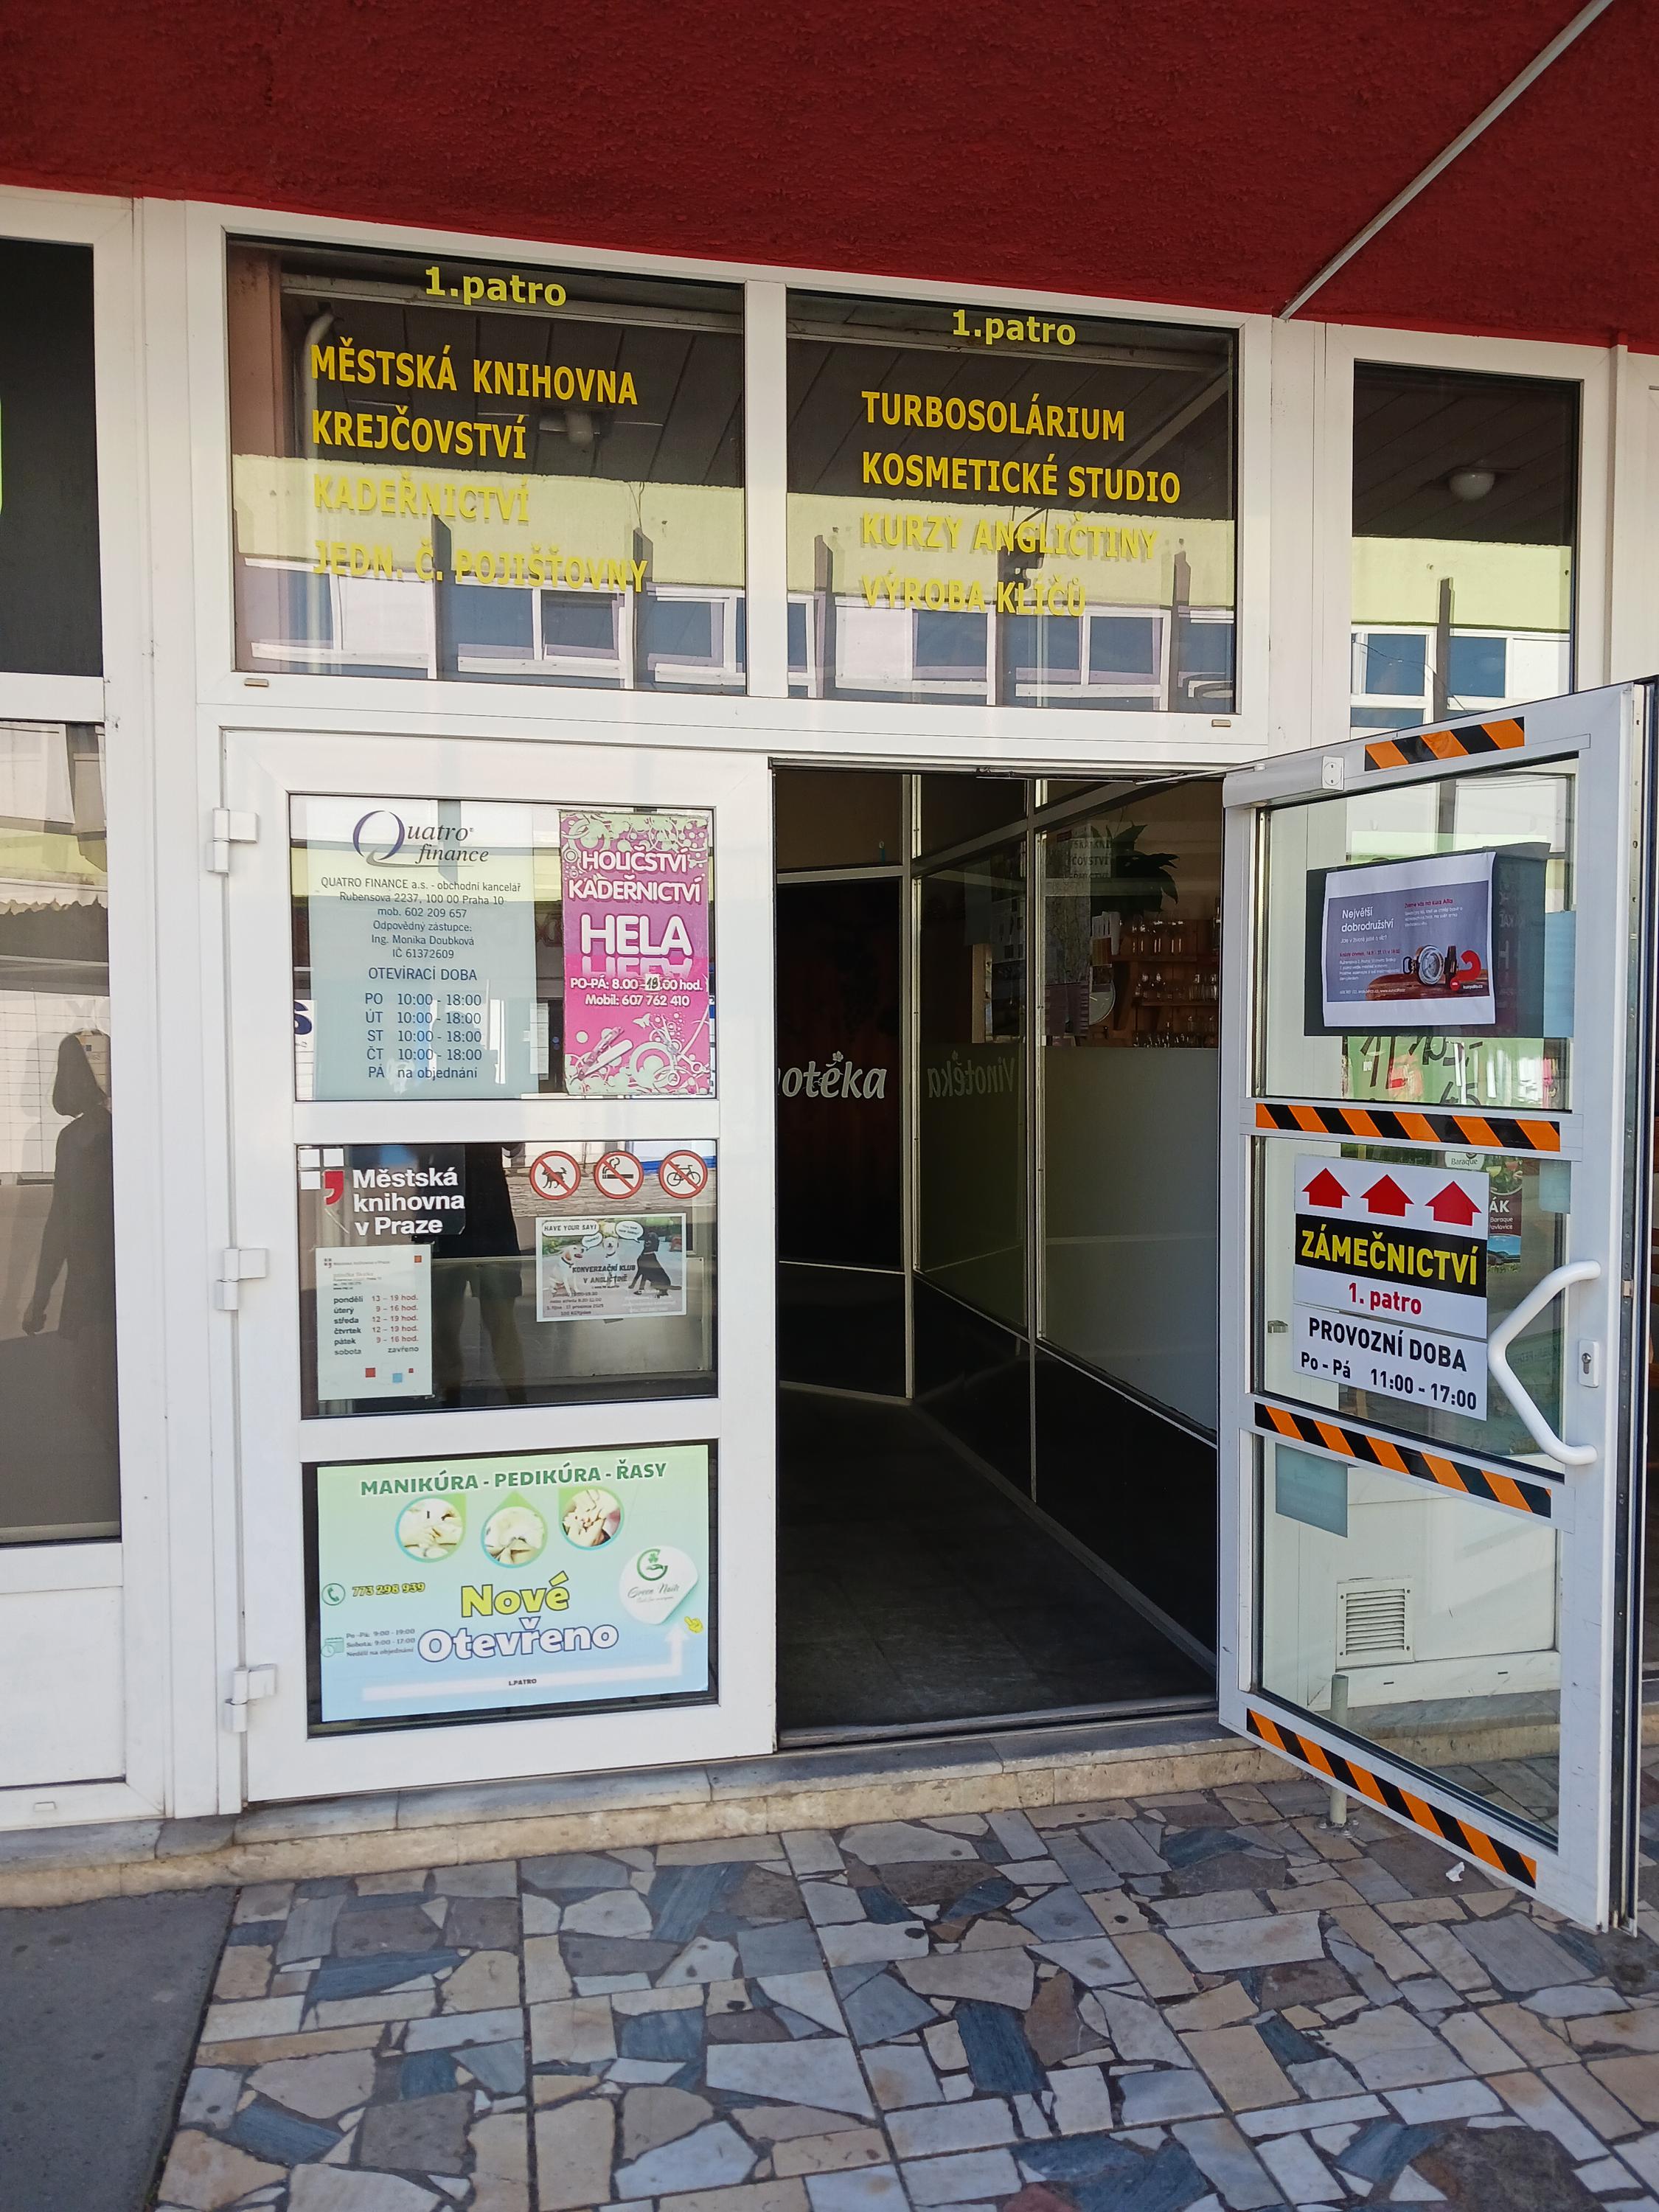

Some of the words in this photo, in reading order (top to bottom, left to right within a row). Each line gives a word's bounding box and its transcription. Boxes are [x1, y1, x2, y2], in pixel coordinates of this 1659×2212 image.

[425, 266, 566, 306] 1.patro
[953, 309, 1077, 346] 1.patro
[311, 336, 457, 392] MĚSTSKÁ
[473, 360, 639, 406] KNIHOVNA
[861, 391, 1125, 442] TURBOSOLÁRIUM
[313, 406, 526, 460] KREJČOVSTVÍ
[863, 451, 1058, 496] KOSMETICKÉ
[1068, 465, 1180, 504] STUDIO
[314, 470, 530, 523] KADEŘNICTVÍ
[862, 512, 963, 549] KURZY
[973, 517, 1159, 560] ANGLIČTINY
[313, 540, 403, 581] JEDN.
[415, 537, 444, 582] Č.
[456, 543, 648, 593] POJIŠŤOVNY
[862, 568, 986, 613] VÝROBA
[997, 577, 1086, 617] KLÍČŮ
[415, 843, 489, 864] finance
[581, 845, 691, 874] HOLIČSTVÍ
[321, 877, 361, 889] QUATRO
[366, 878, 408, 889] FINANCE
[411, 881, 428, 889] a.s.
[437, 881, 479, 891] obchodní
[482, 882, 521, 892] kancelář
[568, 873, 703, 903] KADEŘNICTVÍ
[339, 891, 391, 902] Rubensova
[426, 894, 443, 904] 100
[447, 894, 459, 904] 00
[462, 895, 489, 905] Praha
[493, 896, 504, 905] 10
[378, 907, 401, 917] mob.
[405, 908, 423, 917] 602
[427, 908, 446, 917] 209
[449, 908, 467, 918] 657
[1342, 906, 1374, 919] Největší
[373, 919, 424, 932] Odpovědný
[428, 922, 473, 932] zástupce:
[580, 914, 694, 957] HELA
[1341, 918, 1394, 933] dobrodružství
[372, 934, 389, 945] Ing.
[392, 935, 426, 945] Monika
[429, 936, 474, 945] Doubková
[392, 947, 403, 958] IČ
[406, 949, 454, 959] 61372609
[369, 965, 436, 980] OTEVÍRACÍ
[441, 969, 478, 981] DOBA
[679, 979, 703, 991] hod.
[365, 992, 383, 1004] PO
[397, 993, 433, 1005] 10:00
[446, 994, 481, 1006] 18:00
[585, 994, 619, 1006] Mobil:
[622, 995, 644, 1006] 607
[646, 995, 667, 1006] 762
[669, 995, 690, 1006] 410
[366, 1008, 383, 1023] ÚT
[397, 1012, 433, 1023] 10:00
[446, 1012, 481, 1024] 18:00
[367, 1029, 383, 1042] ST
[398, 1030, 434, 1042] 10:00
[447, 1031, 481, 1043] 18:00
[366, 1046, 384, 1060] ČT
[398, 1048, 434, 1060] 10:00
[447, 1048, 482, 1060] 18:00
[369, 1063, 385, 1078] PÁ
[397, 1069, 413, 1078] na
[417, 1067, 478, 1081] objednání
[352, 1166, 459, 1189] Městská
[353, 1193, 465, 1212] knihovna
[355, 1221, 369, 1236] v
[375, 1217, 443, 1235] Praze
[1301, 1224, 1478, 1286] ZÁMEČNICTVÍ
[1349, 1283, 1364, 1304] 1.
[1370, 1290, 1422, 1315] patro
[1309, 1317, 1403, 1357] PROVOZNÍ
[1410, 1340, 1467, 1372] DOBA
[1301, 1352, 1318, 1371] Po
[1333, 1360, 1351, 1379] Pá
[1371, 1368, 1413, 1394] 11:00
[1430, 1383, 1477, 1411] 17:00
[361, 1470, 479, 1496] MANIKÚRA
[494, 1462, 601, 1488] PEDIKÚRA
[616, 1459, 667, 1480] ŘASY
[352, 1585, 374, 1597] 773
[376, 1584, 400, 1595] 298
[402, 1582, 425, 1593] 939
[461, 1571, 571, 1618] Nové
[417, 1616, 619, 1663] Otevřeno
